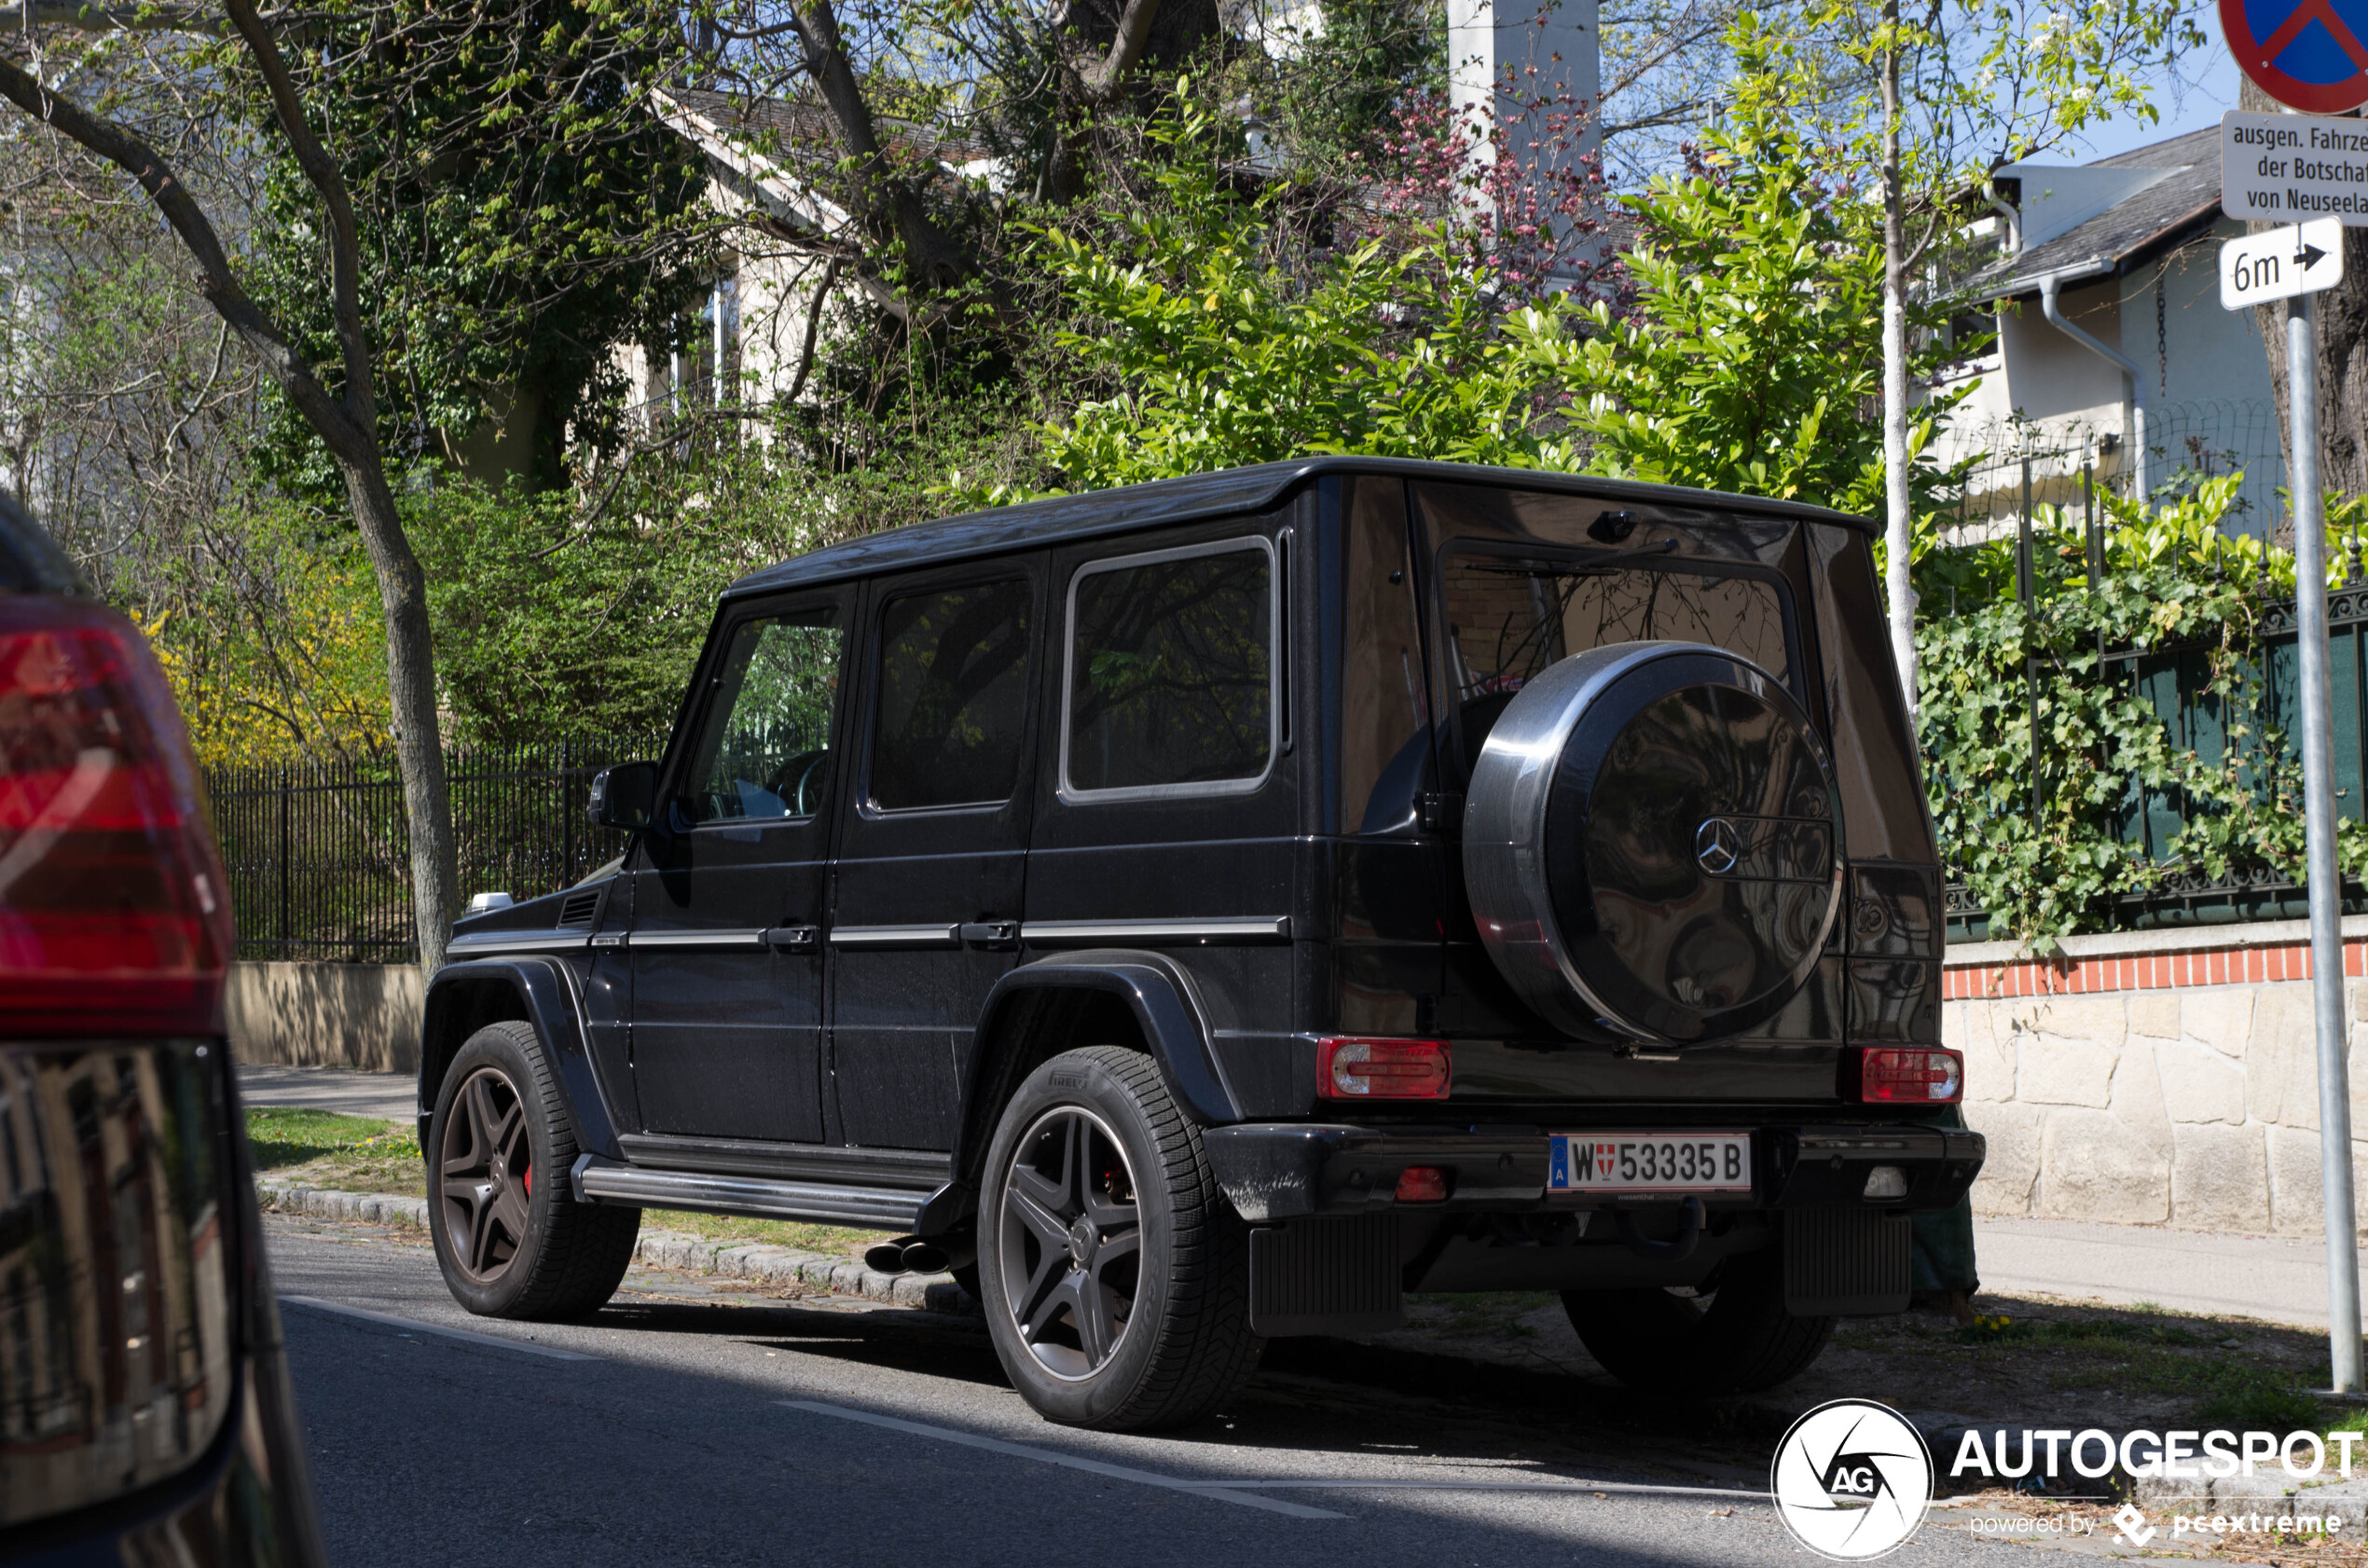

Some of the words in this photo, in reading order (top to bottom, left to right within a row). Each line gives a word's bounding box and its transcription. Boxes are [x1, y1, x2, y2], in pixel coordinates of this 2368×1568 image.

[2234, 127, 2304, 150] ausgen.
[2258, 156, 2287, 177] der
[2247, 190, 2280, 210] von
[2287, 189, 2368, 213] Neuseela
[2234, 253, 2279, 292] 6m
[1572, 1143, 1594, 1181] W
[1620, 1143, 1716, 1181] 53335
[1725, 1144, 1741, 1180] B
[1555, 1169, 1563, 1181] A
